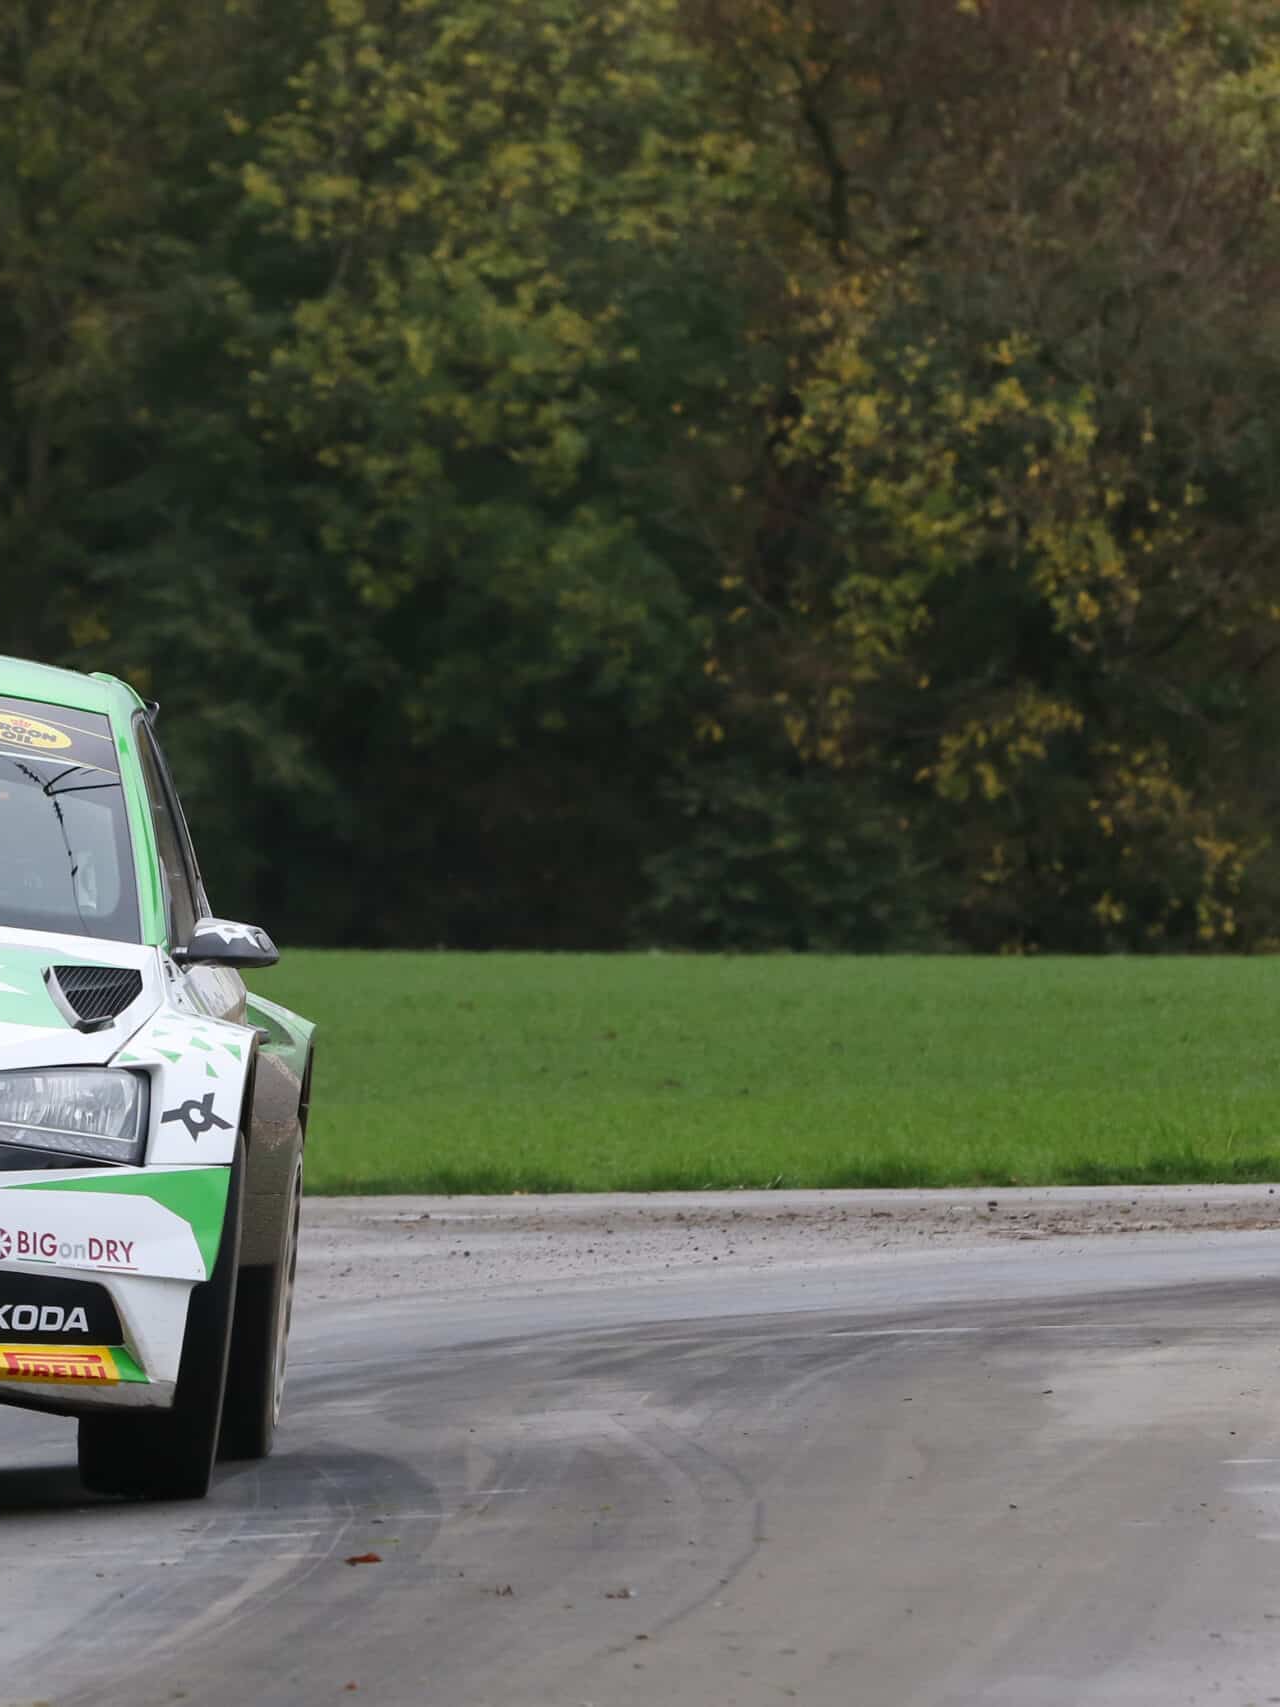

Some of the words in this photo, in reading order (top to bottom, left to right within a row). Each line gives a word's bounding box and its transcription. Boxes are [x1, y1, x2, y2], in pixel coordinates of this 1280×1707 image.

[1, 731, 33, 745] OIL
[16, 1230, 134, 1263] BIGonDRY
[3, 1352, 108, 1380] PIRELLI
